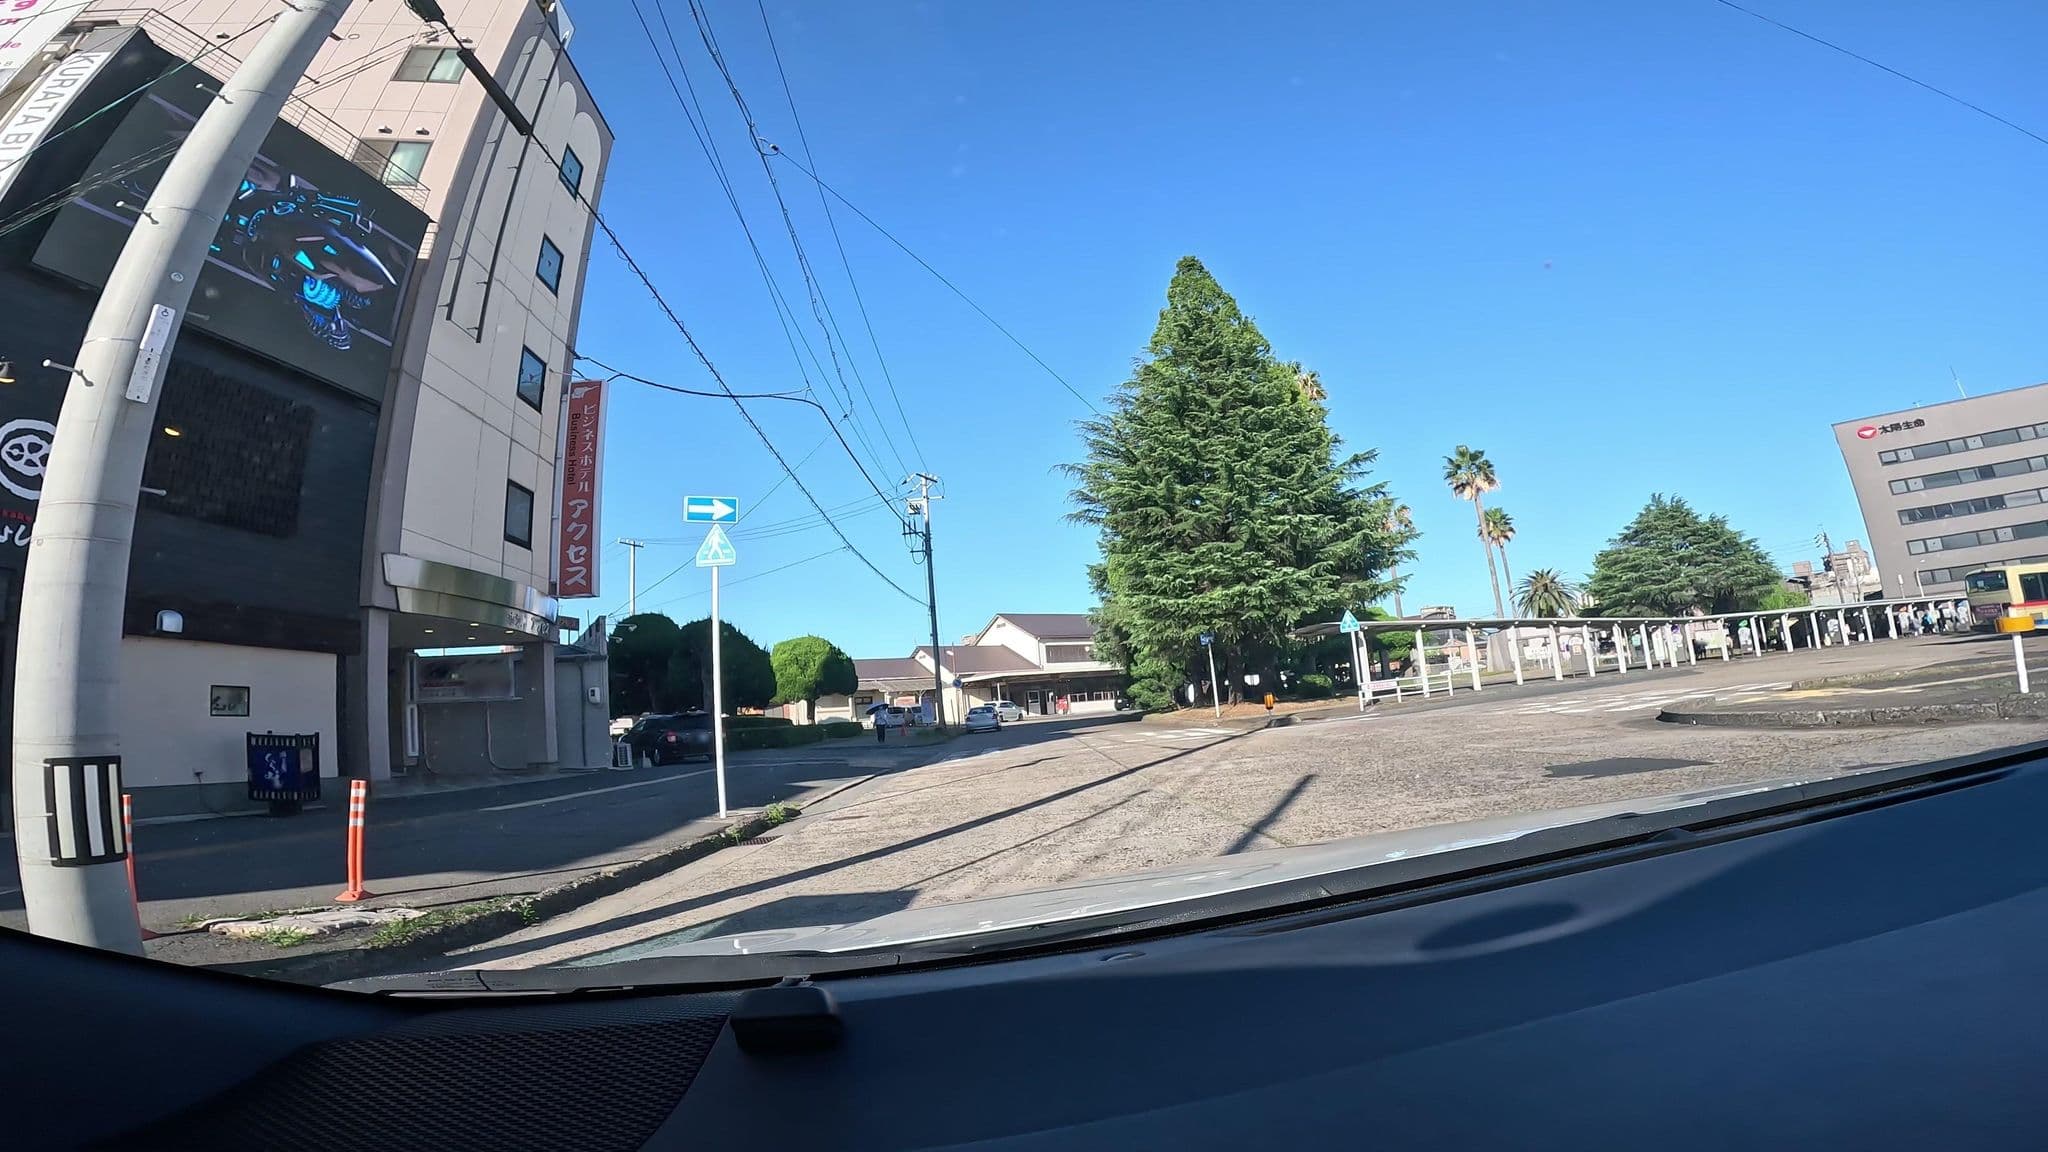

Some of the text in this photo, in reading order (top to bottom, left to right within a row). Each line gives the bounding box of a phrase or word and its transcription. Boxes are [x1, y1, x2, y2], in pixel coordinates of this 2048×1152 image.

[14, 54, 101, 127] KURATA
[567, 413, 580, 485] Business Hotel
[1878, 418, 1925, 435] 太陽生命
[565, 404, 597, 586] ビジネスホテル アクセス
